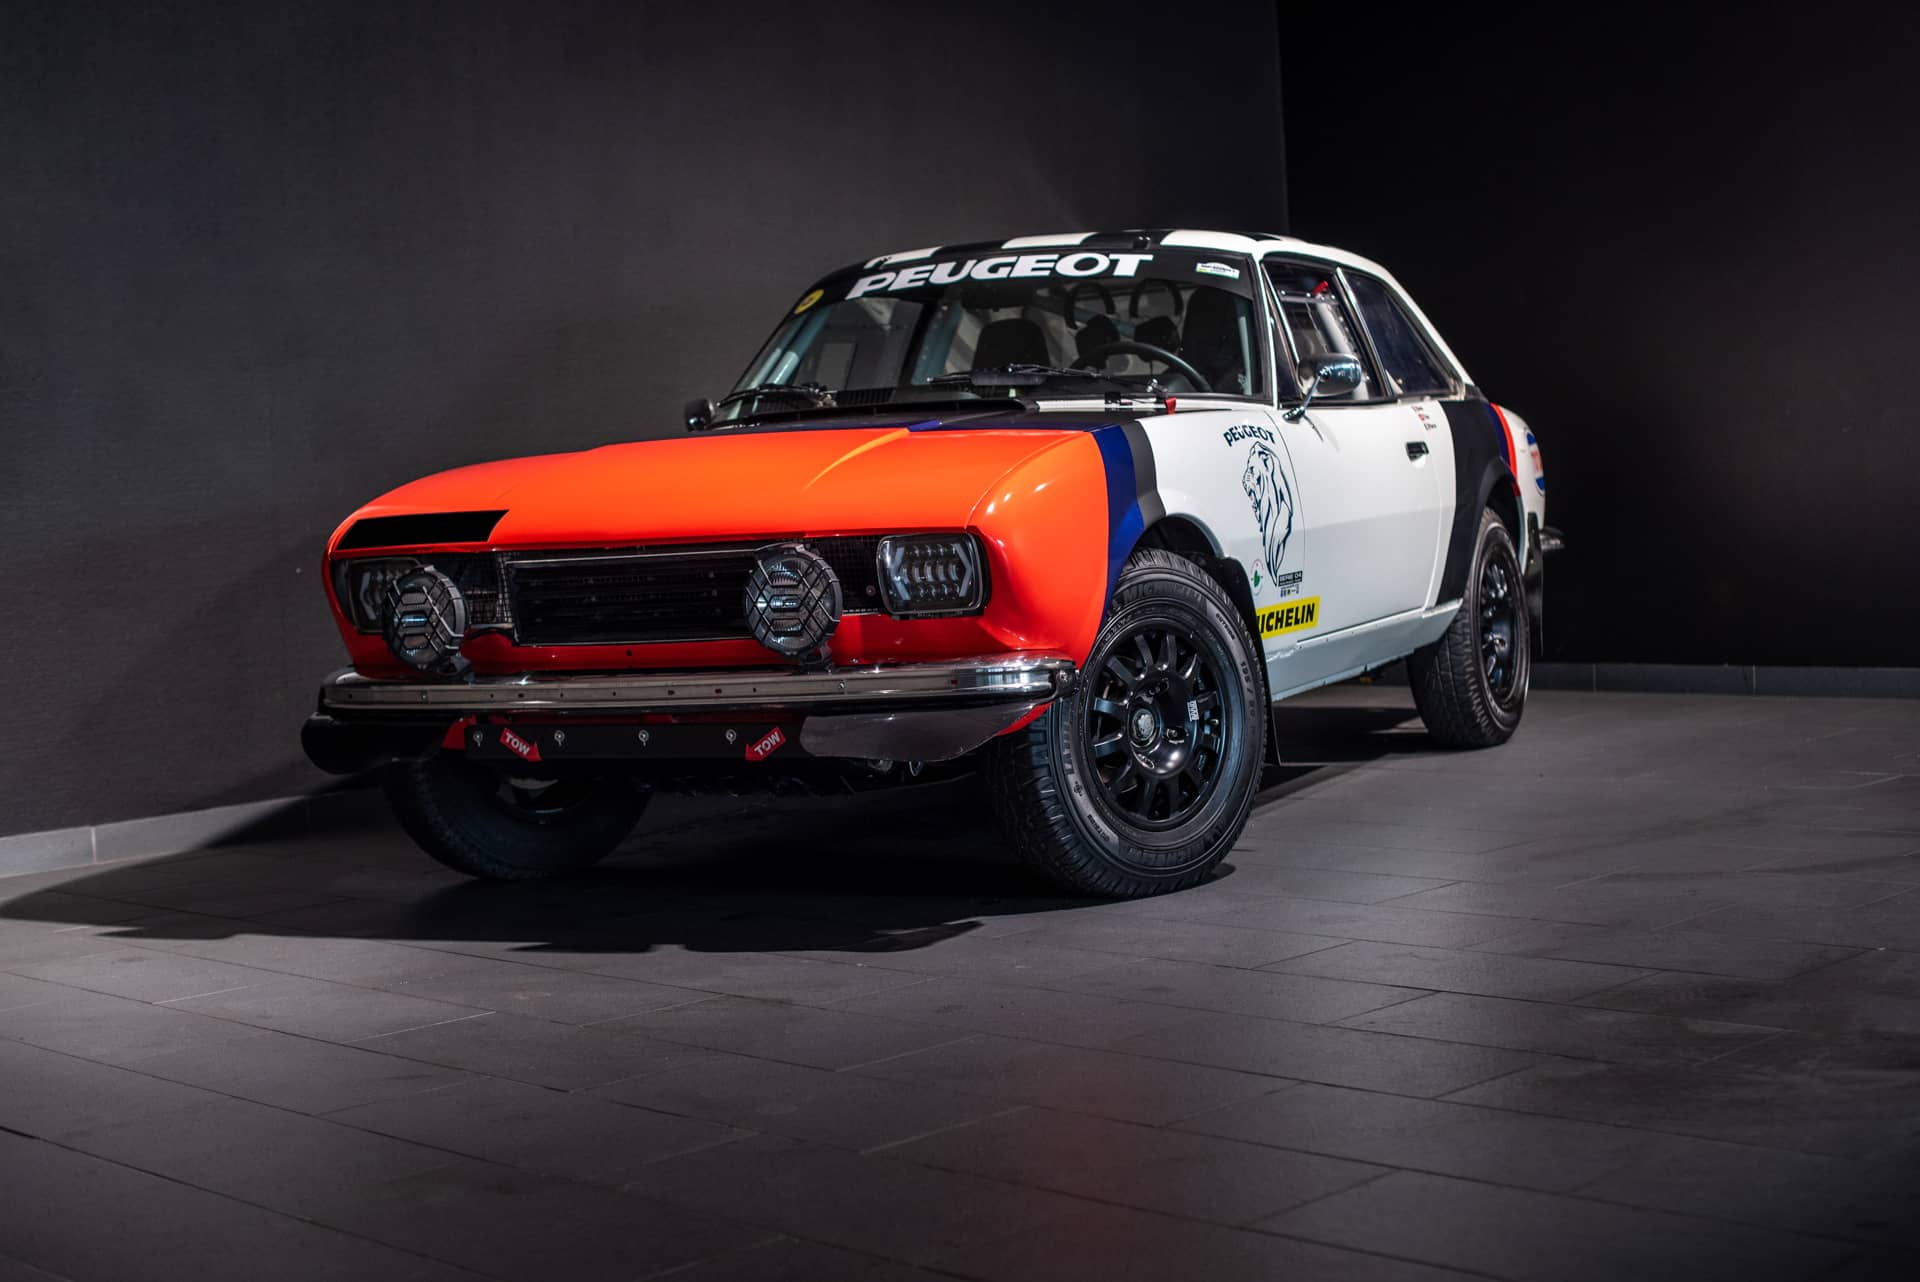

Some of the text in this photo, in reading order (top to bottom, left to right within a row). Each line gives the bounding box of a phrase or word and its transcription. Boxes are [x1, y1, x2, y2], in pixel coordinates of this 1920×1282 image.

[844, 252, 1154, 300] PEUGEOT
[1223, 424, 1276, 447] PEUGEOT
[504, 731, 531, 757] TOW
[753, 731, 782, 757] TOW
